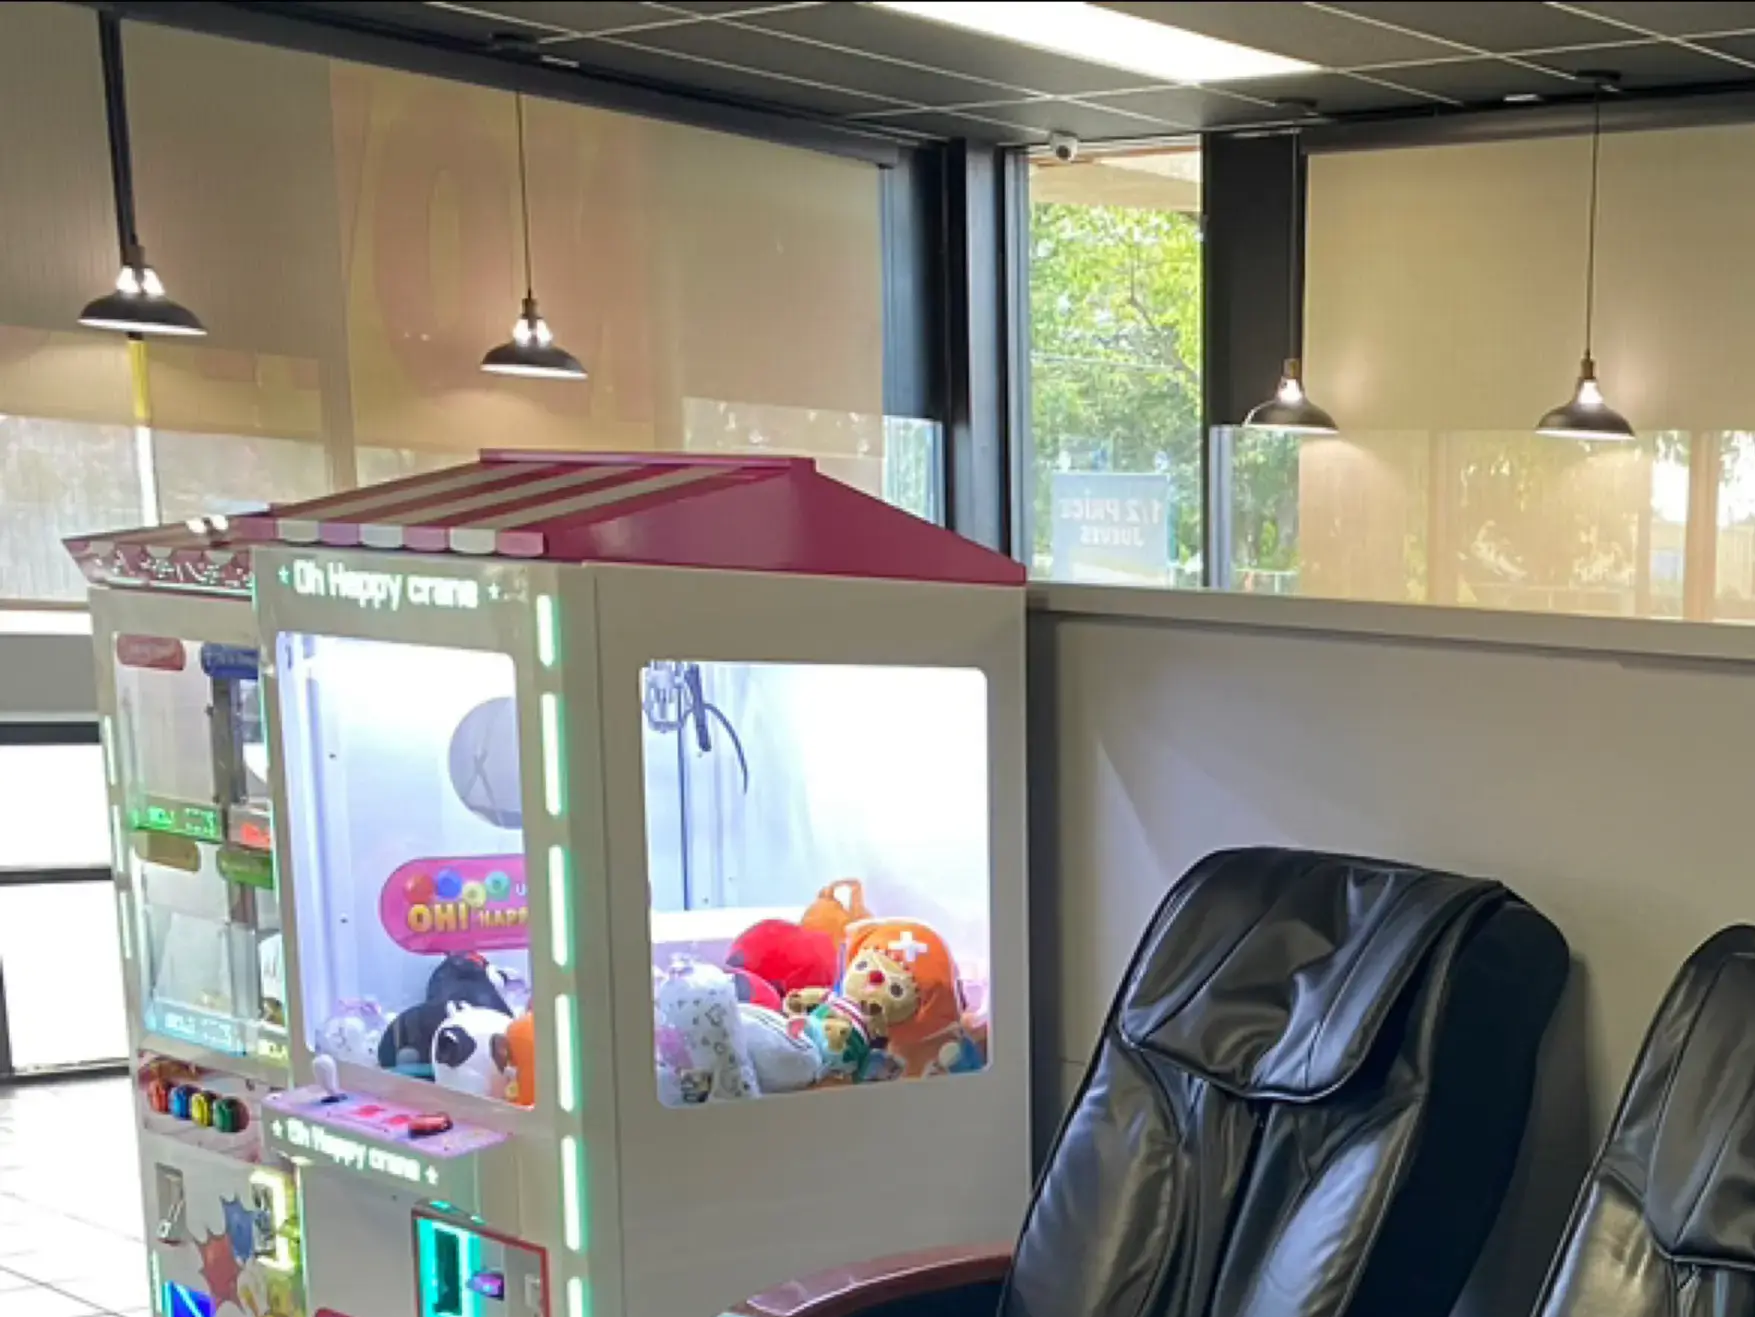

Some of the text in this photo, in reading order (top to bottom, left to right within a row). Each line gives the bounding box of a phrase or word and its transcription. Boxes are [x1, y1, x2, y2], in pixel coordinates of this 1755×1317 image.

[293, 557, 480, 612] Oh Happy crane
[407, 902, 470, 933] OH!
[286, 1116, 311, 1149] Oh
[310, 1124, 368, 1171] Happy
